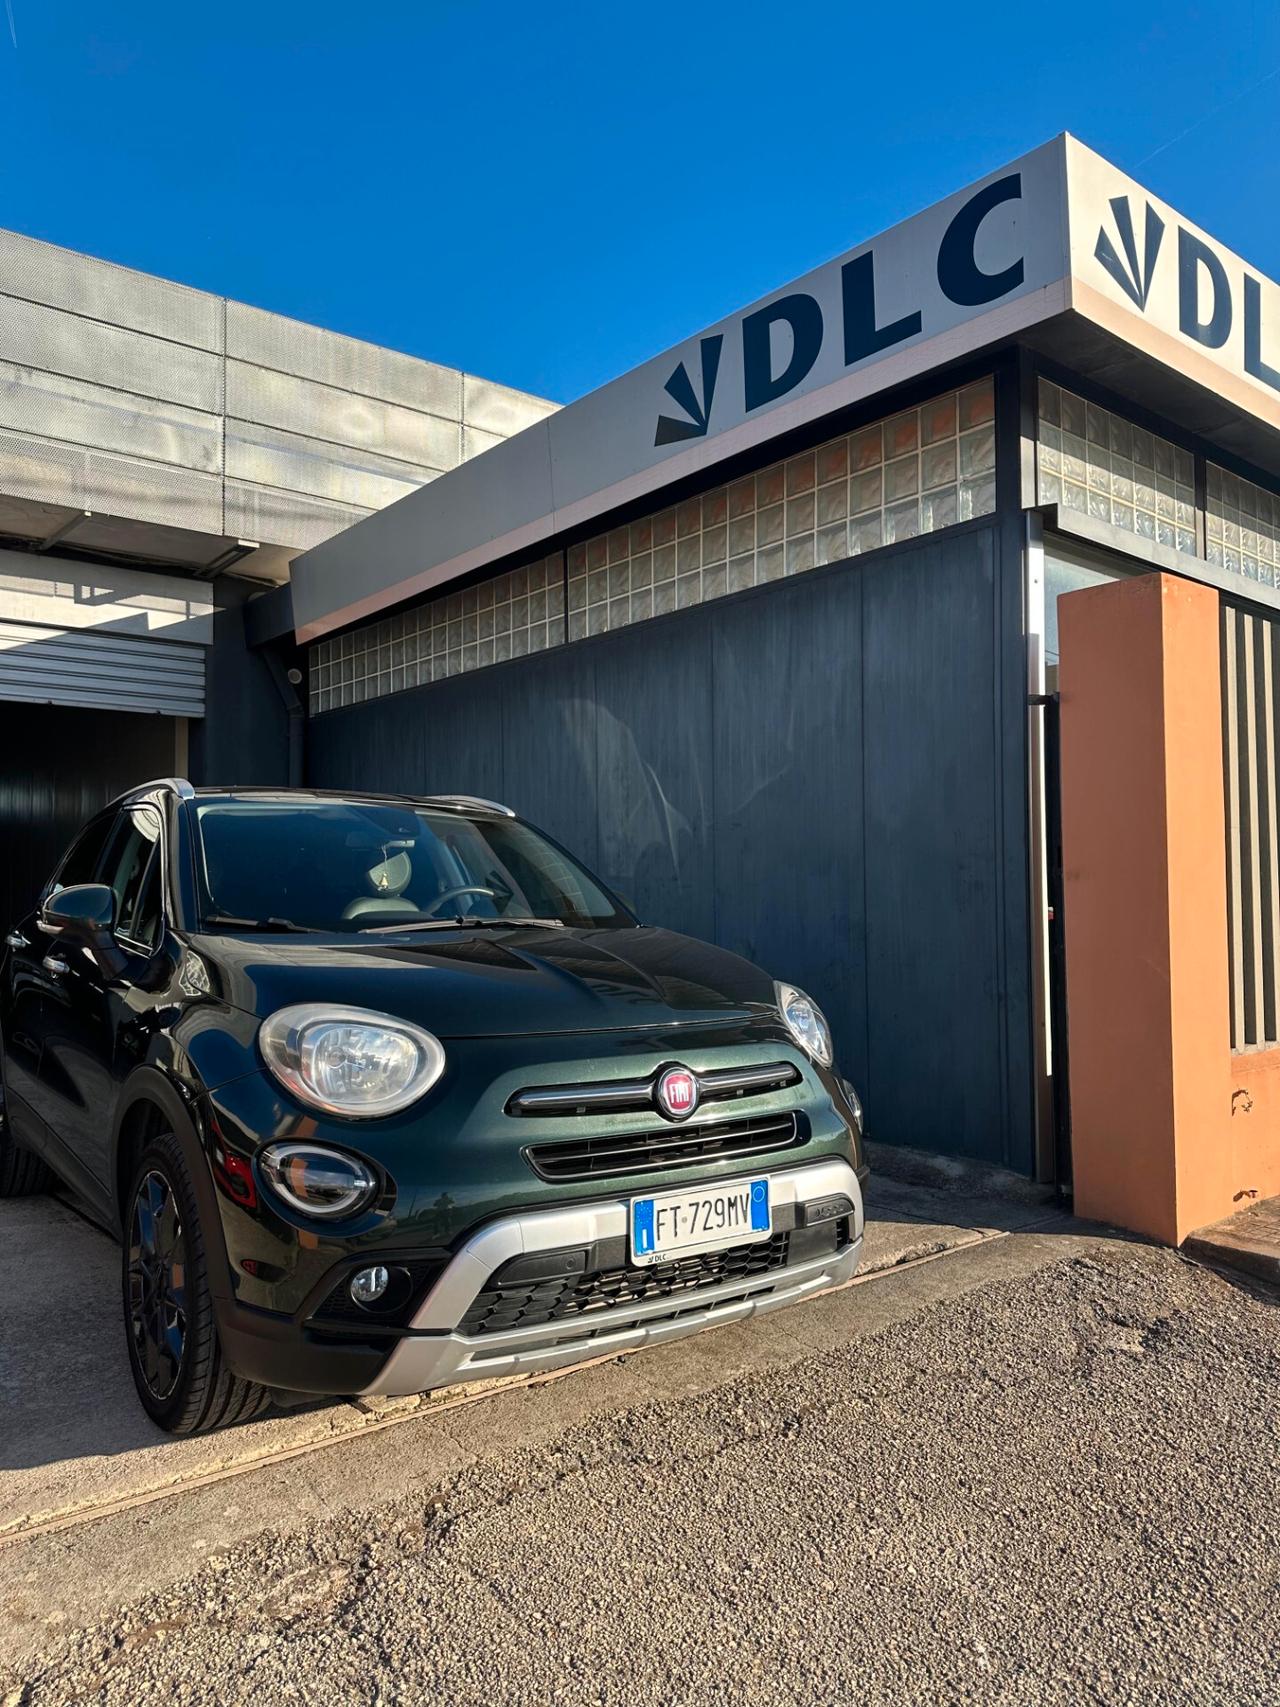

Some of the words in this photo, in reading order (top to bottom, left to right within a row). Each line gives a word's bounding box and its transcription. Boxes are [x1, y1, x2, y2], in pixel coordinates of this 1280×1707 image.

[742, 172, 1025, 413] DLC
[669, 1081, 690, 1104] FIAT
[654, 1253, 667, 1262] DLC
